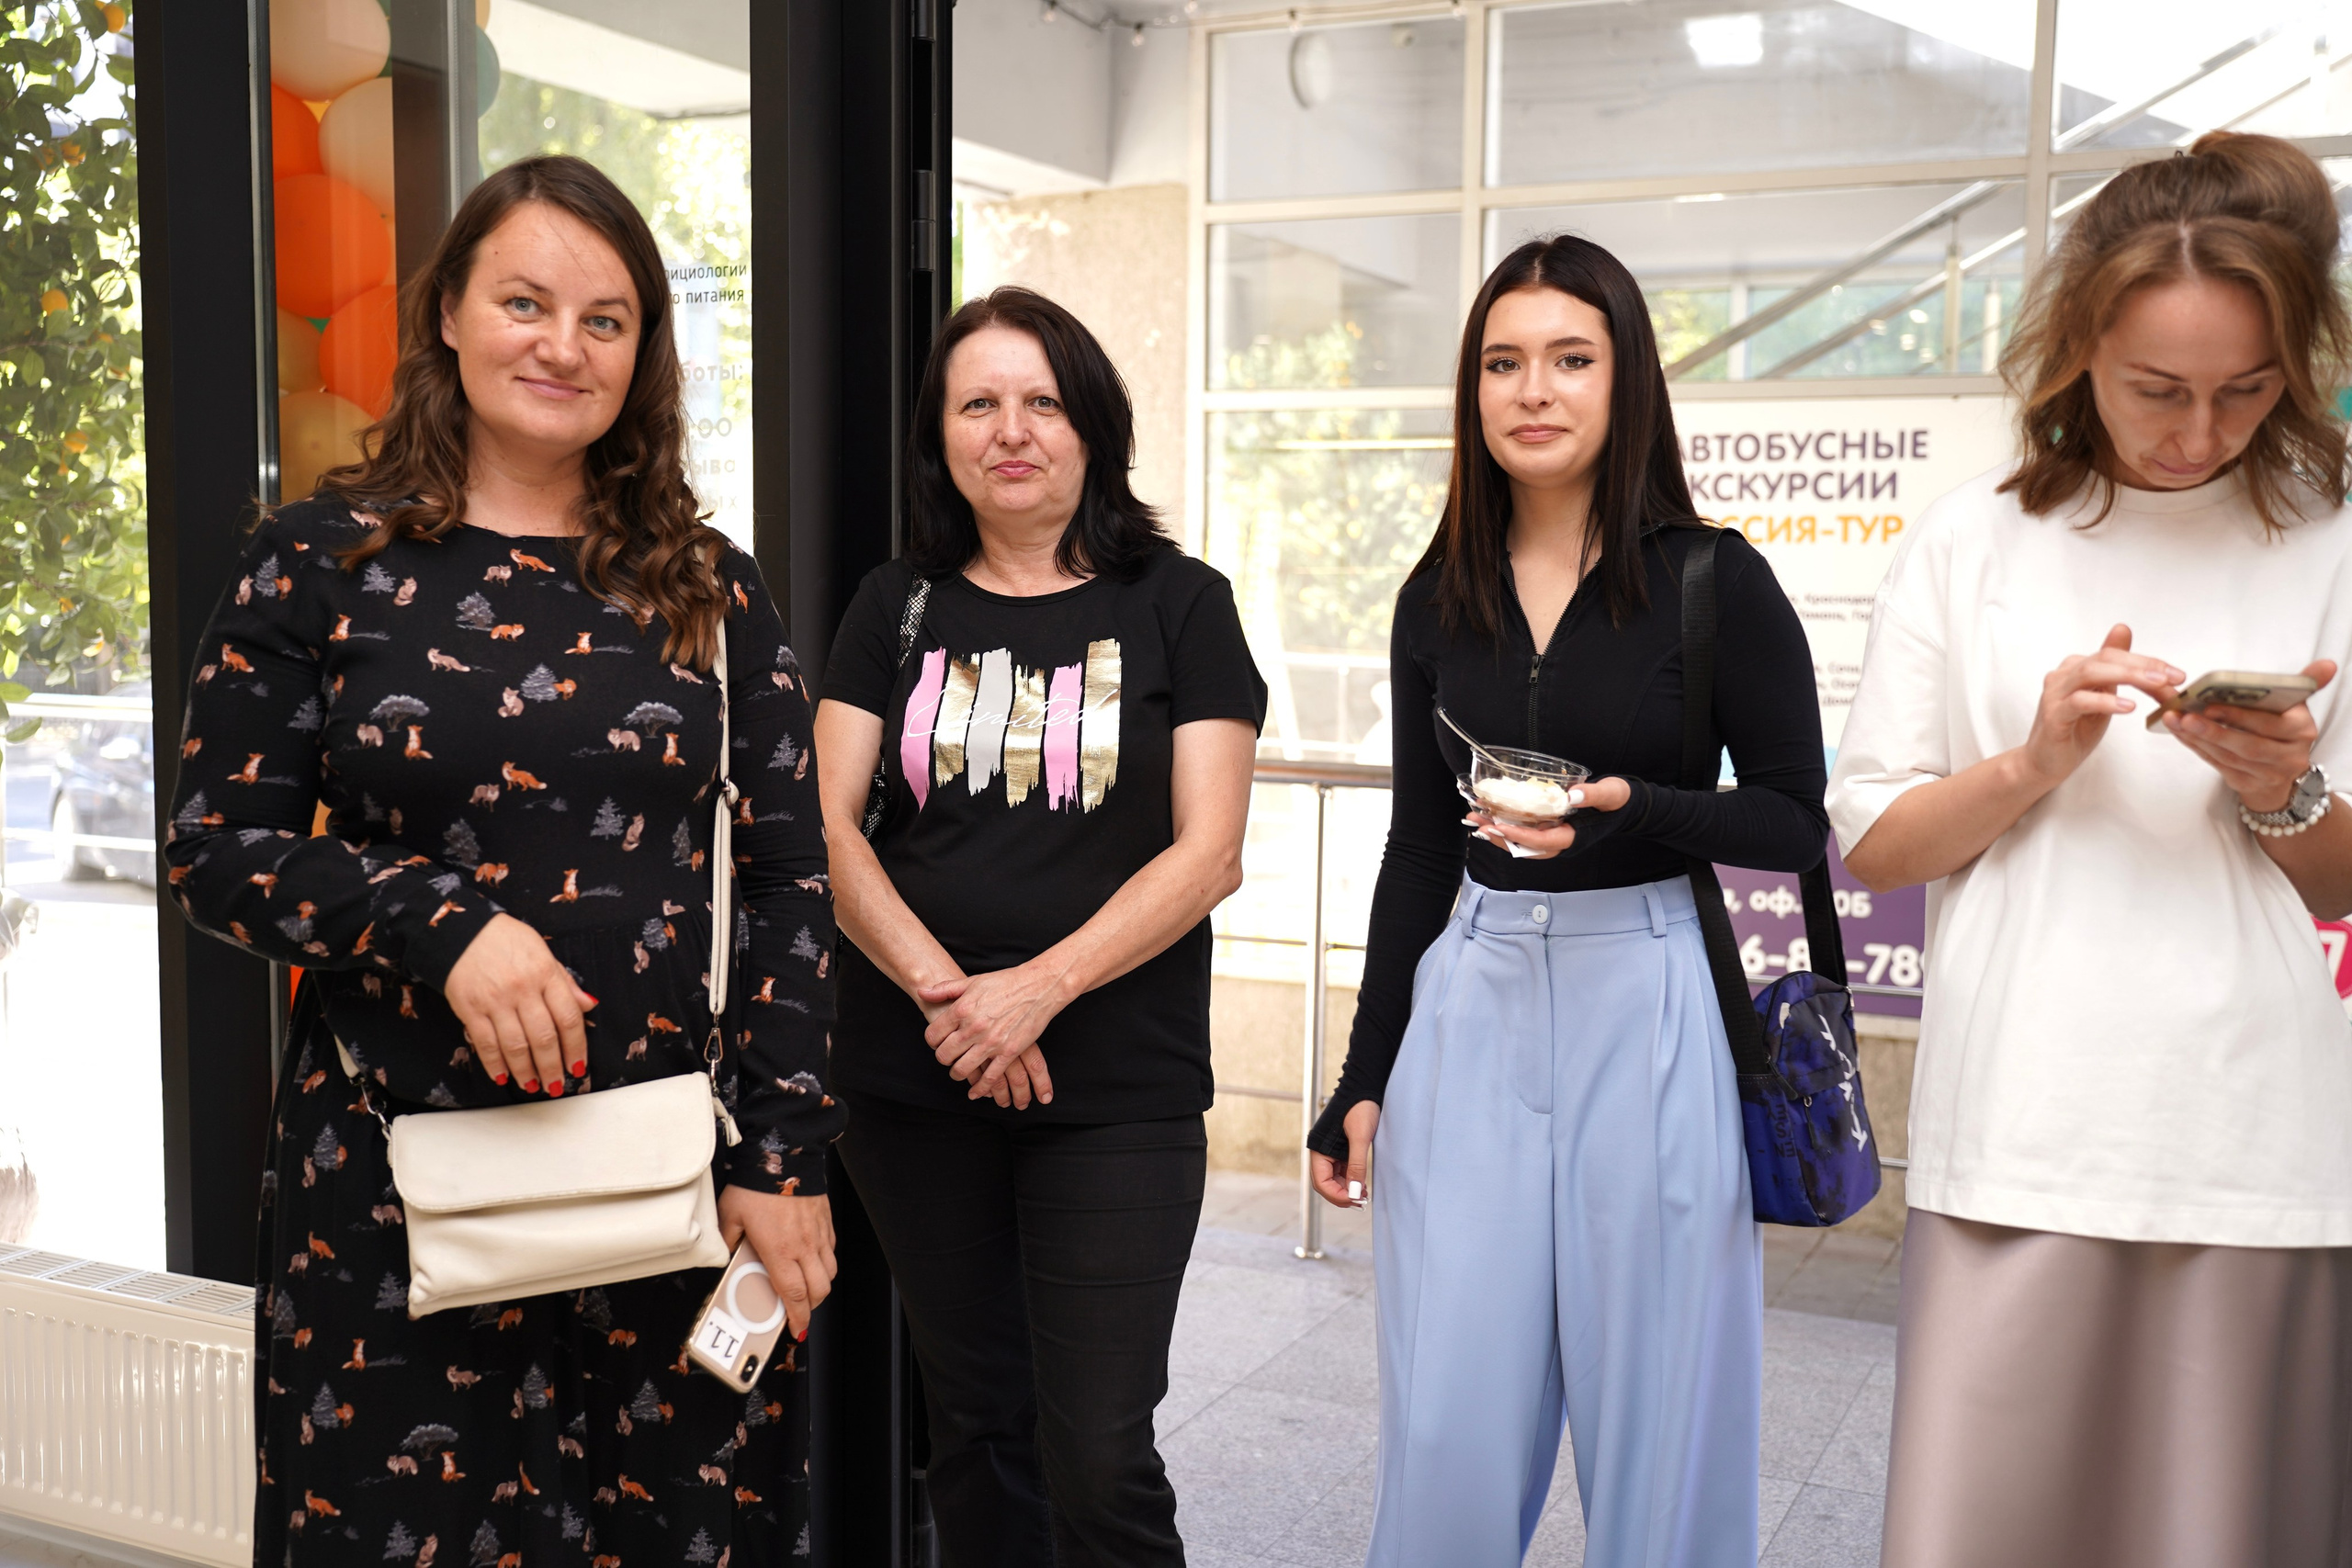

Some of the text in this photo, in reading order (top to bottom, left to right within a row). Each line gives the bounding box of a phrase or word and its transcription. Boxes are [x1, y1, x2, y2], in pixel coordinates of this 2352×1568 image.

[686, 289, 745, 304] питания
[683, 364, 743, 382] боты:
[1690, 471, 1898, 502] КСКУРСИИ
[1698, 514, 1905, 545] СИЯ-ТУР
